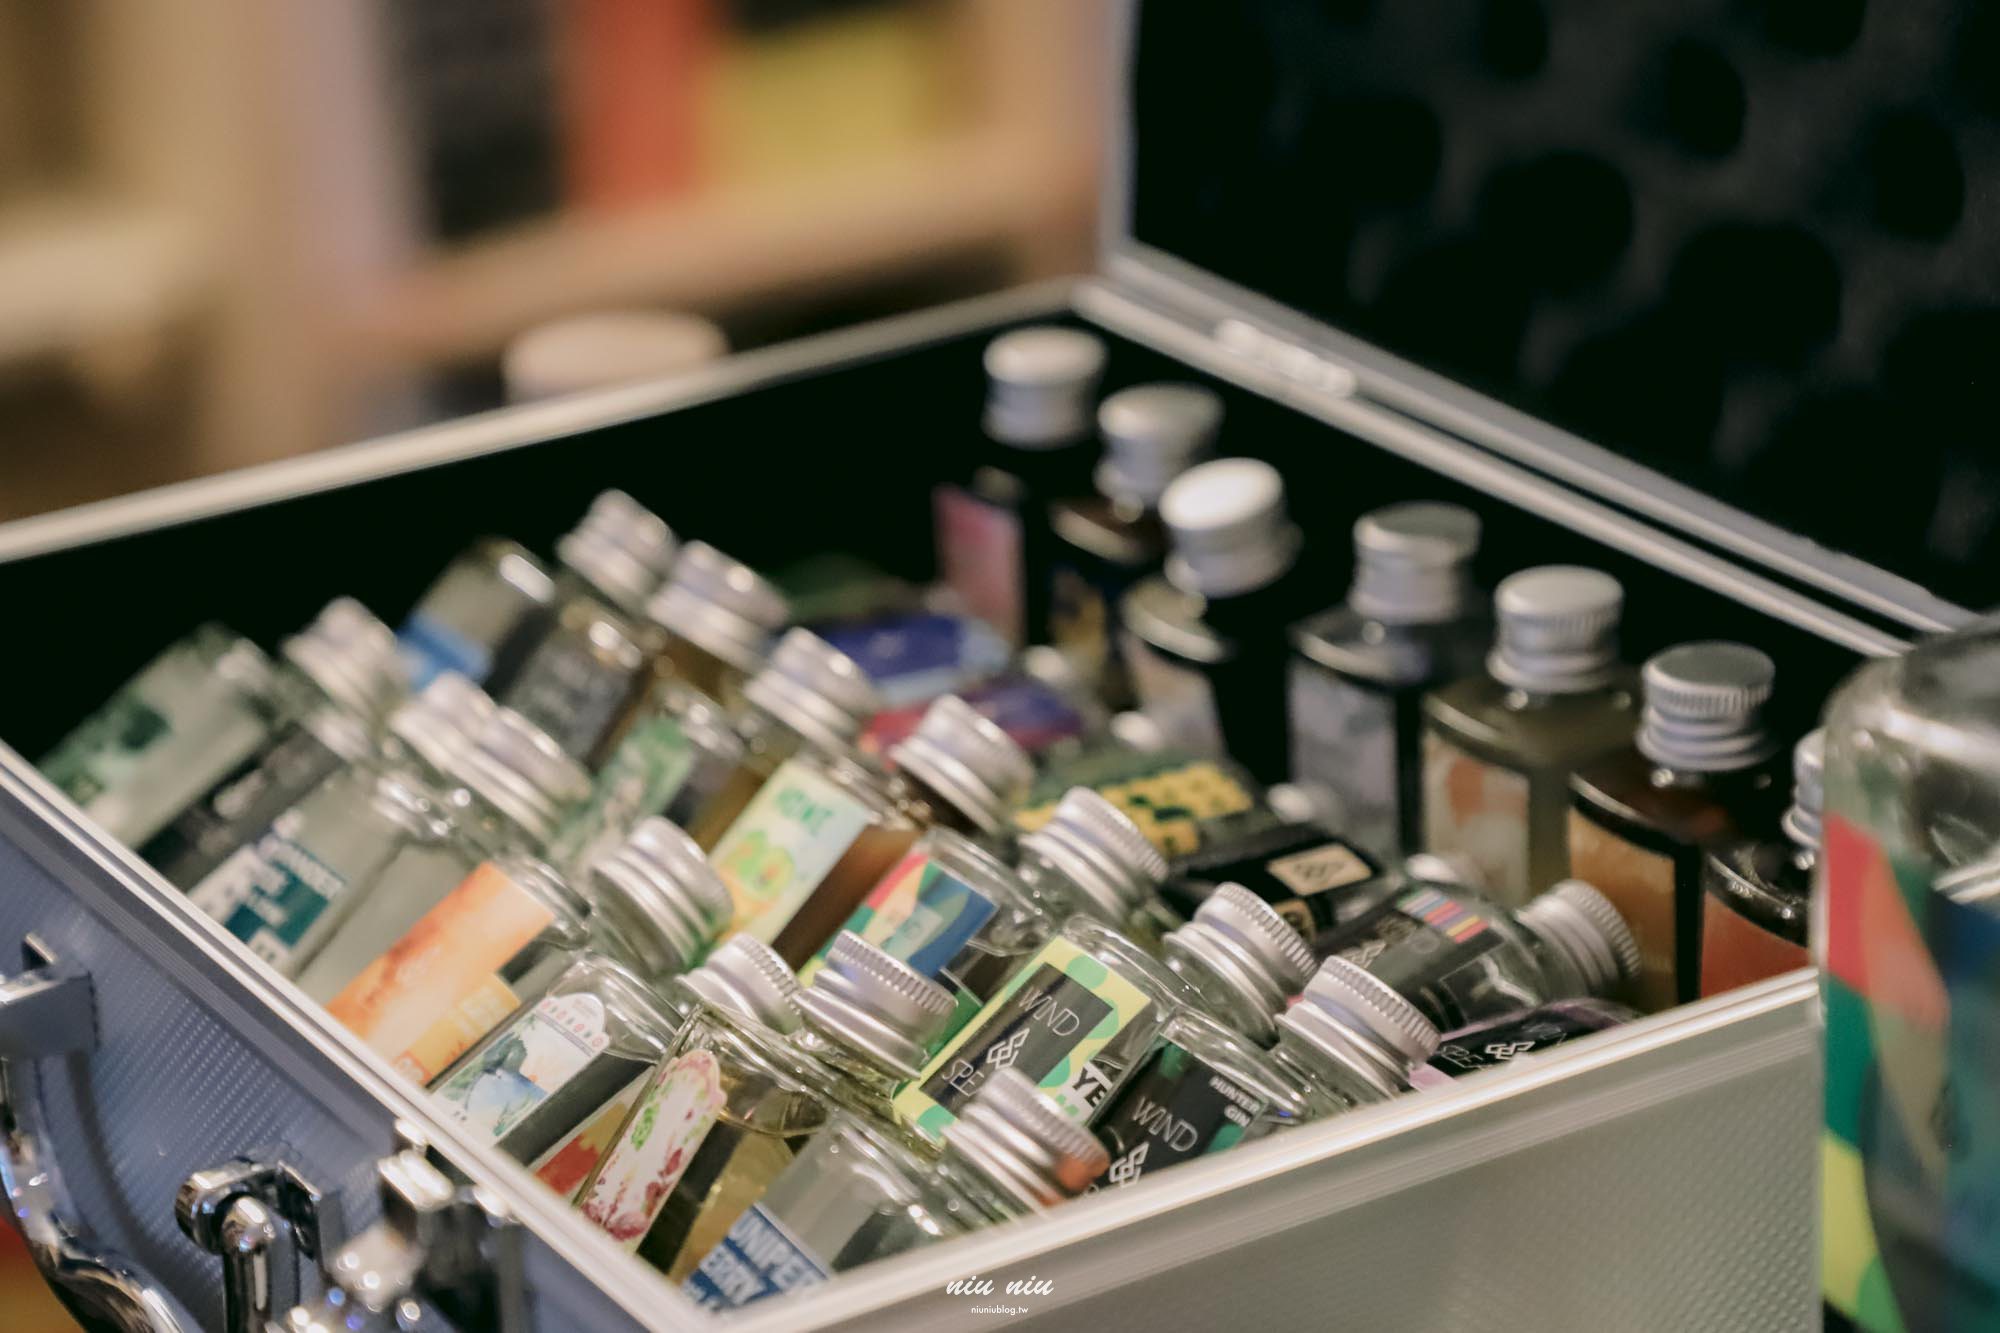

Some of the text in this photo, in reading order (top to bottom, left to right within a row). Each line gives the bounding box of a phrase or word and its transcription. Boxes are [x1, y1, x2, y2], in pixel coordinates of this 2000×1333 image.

[1018, 986, 1081, 1037] WIND
[1208, 1075, 1262, 1114] HUNTER
[1223, 1103, 1251, 1128] GIN
[1132, 1096, 1199, 1152] WIND
